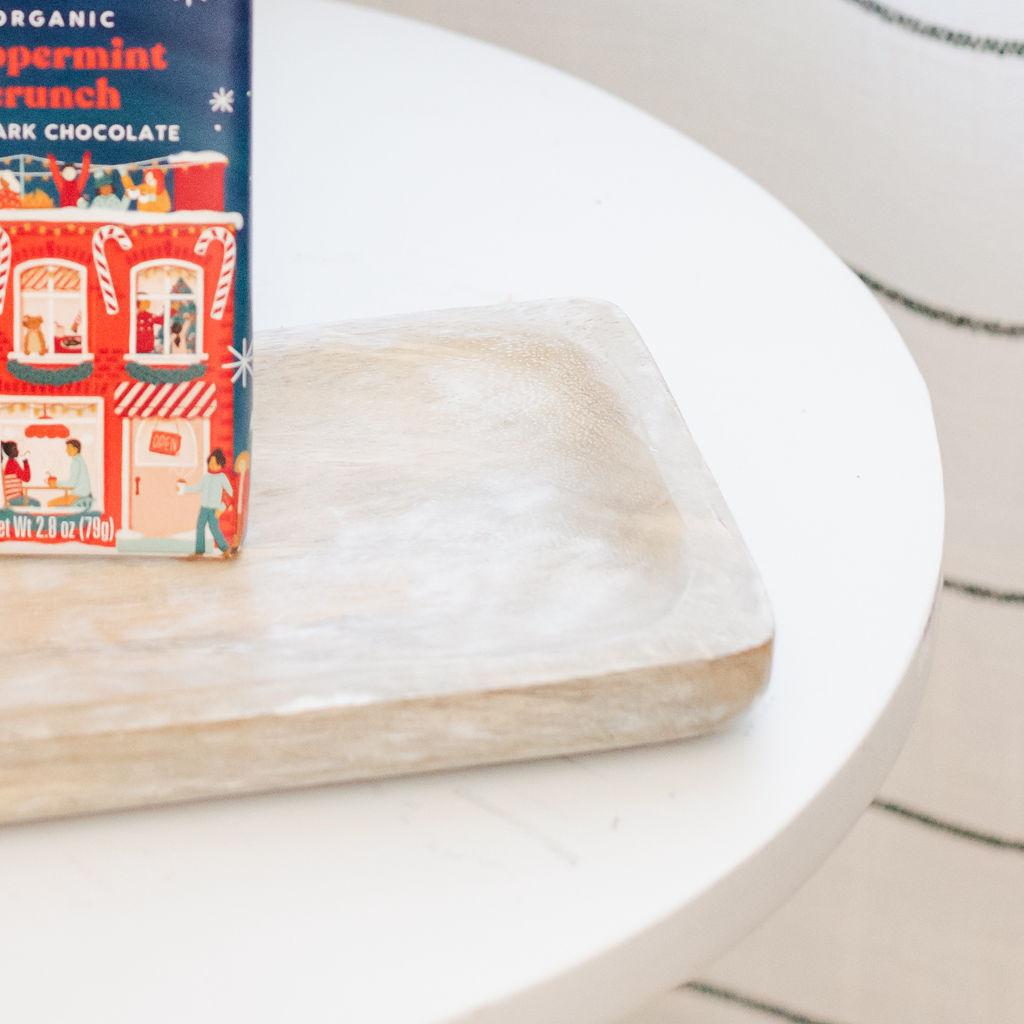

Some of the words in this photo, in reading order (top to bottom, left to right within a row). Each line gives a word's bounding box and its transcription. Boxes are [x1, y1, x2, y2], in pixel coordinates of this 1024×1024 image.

[44, 123, 181, 143] CHOCOLATE
[151, 435, 179, 453] OPEN
[13, 516, 33, 539] Wt
[35, 516, 58, 539] 2.8
[60, 521, 75, 540] oz
[79, 516, 116, 542] (79g)
